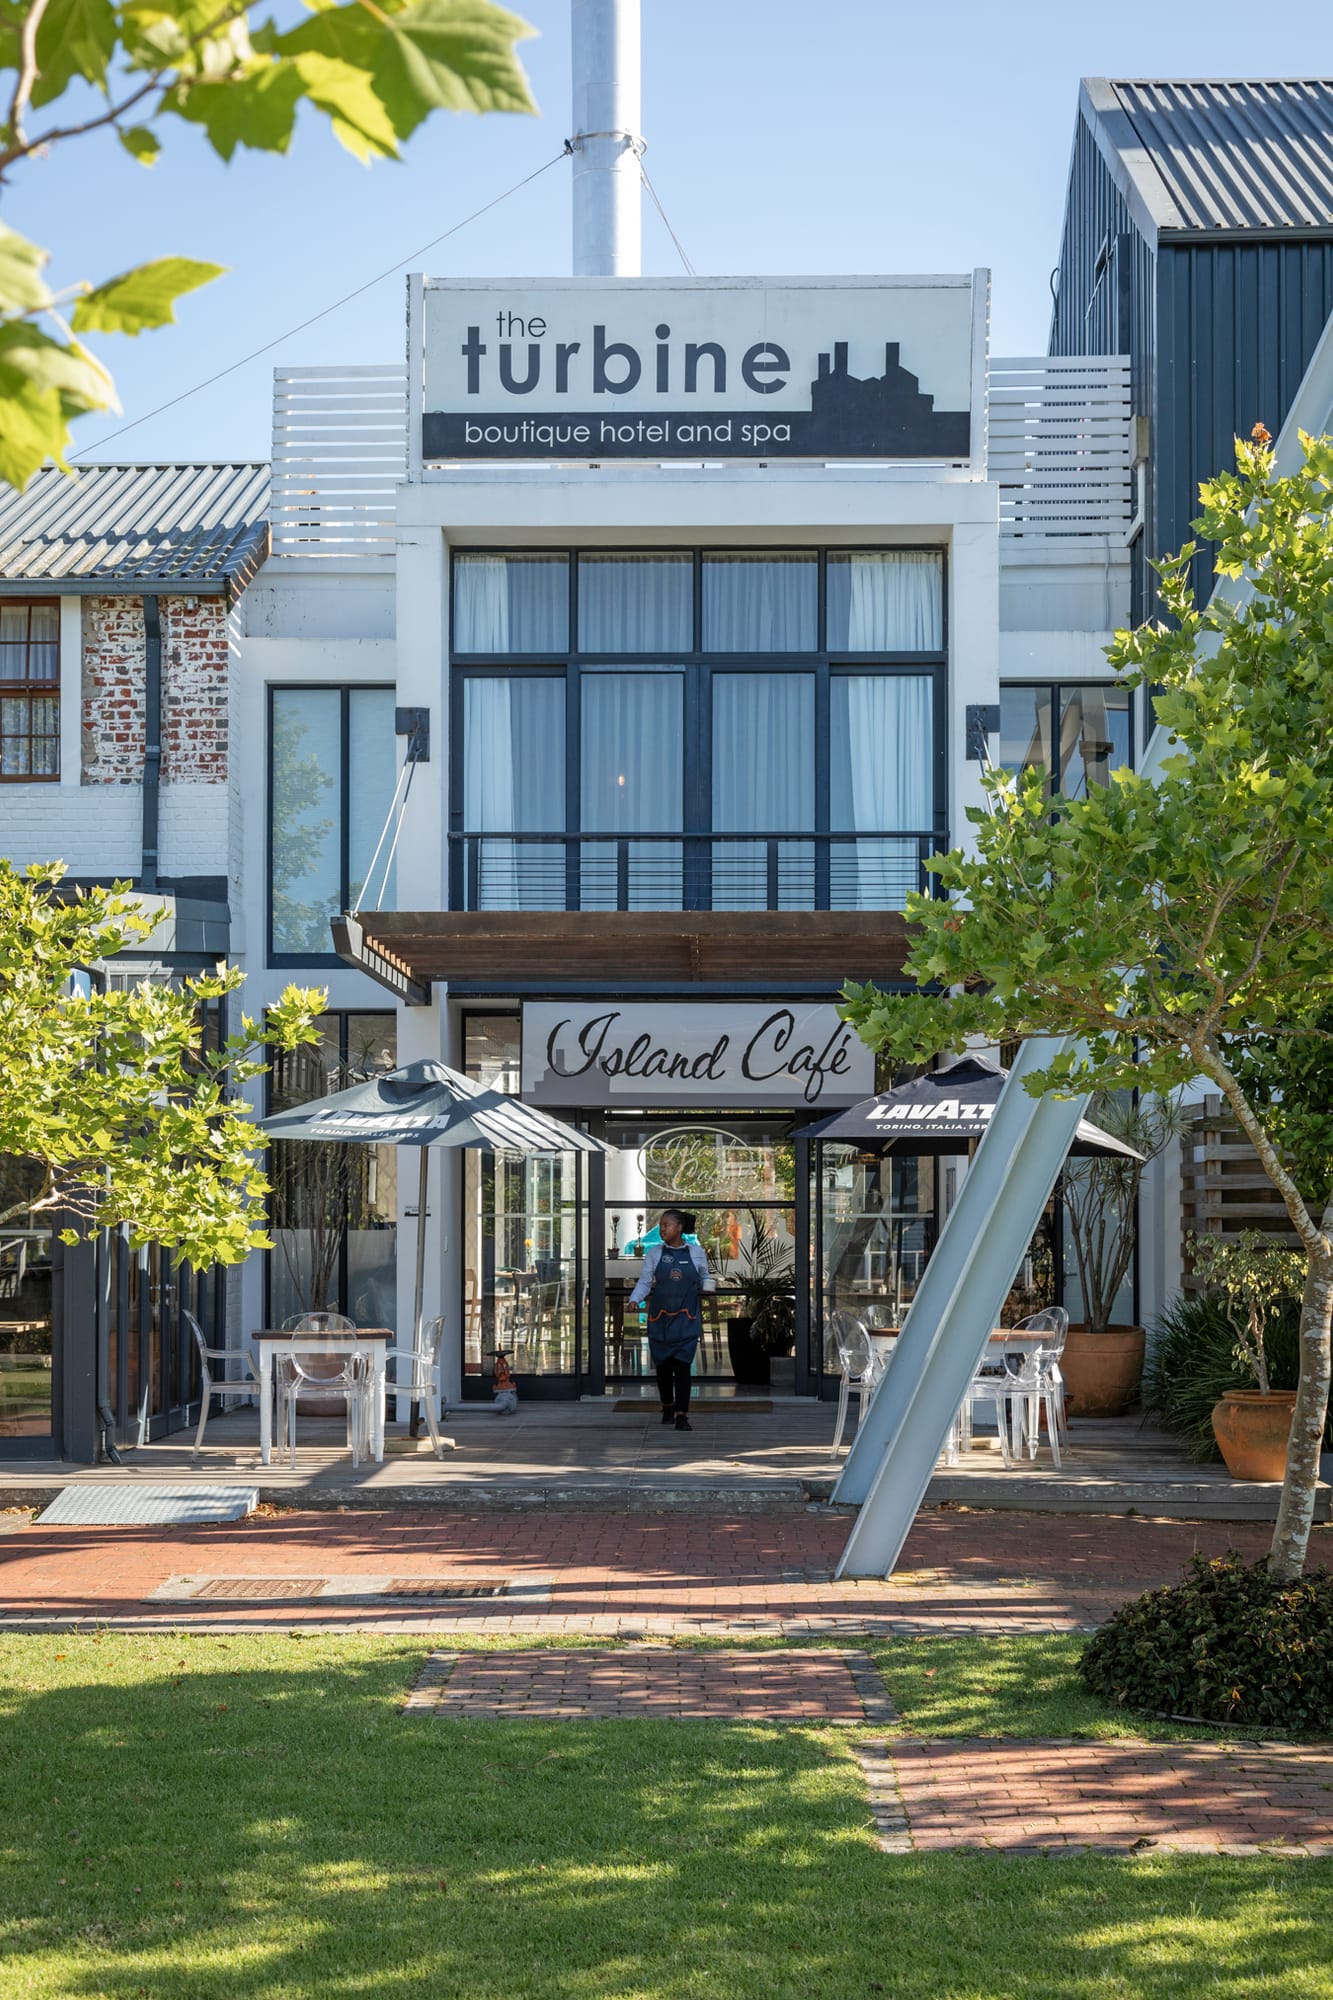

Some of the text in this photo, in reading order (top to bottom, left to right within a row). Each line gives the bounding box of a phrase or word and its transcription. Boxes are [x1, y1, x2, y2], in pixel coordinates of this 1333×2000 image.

[495, 310, 547, 338] the
[461, 323, 791, 395] turbine
[464, 419, 791, 447] boutique hotel and spa
[546, 1008, 852, 1103] Island Café
[304, 1109, 451, 1129] LAVAZZA
[865, 1099, 997, 1120] LAVAZZ
[672, 1158, 726, 1192] Caf
